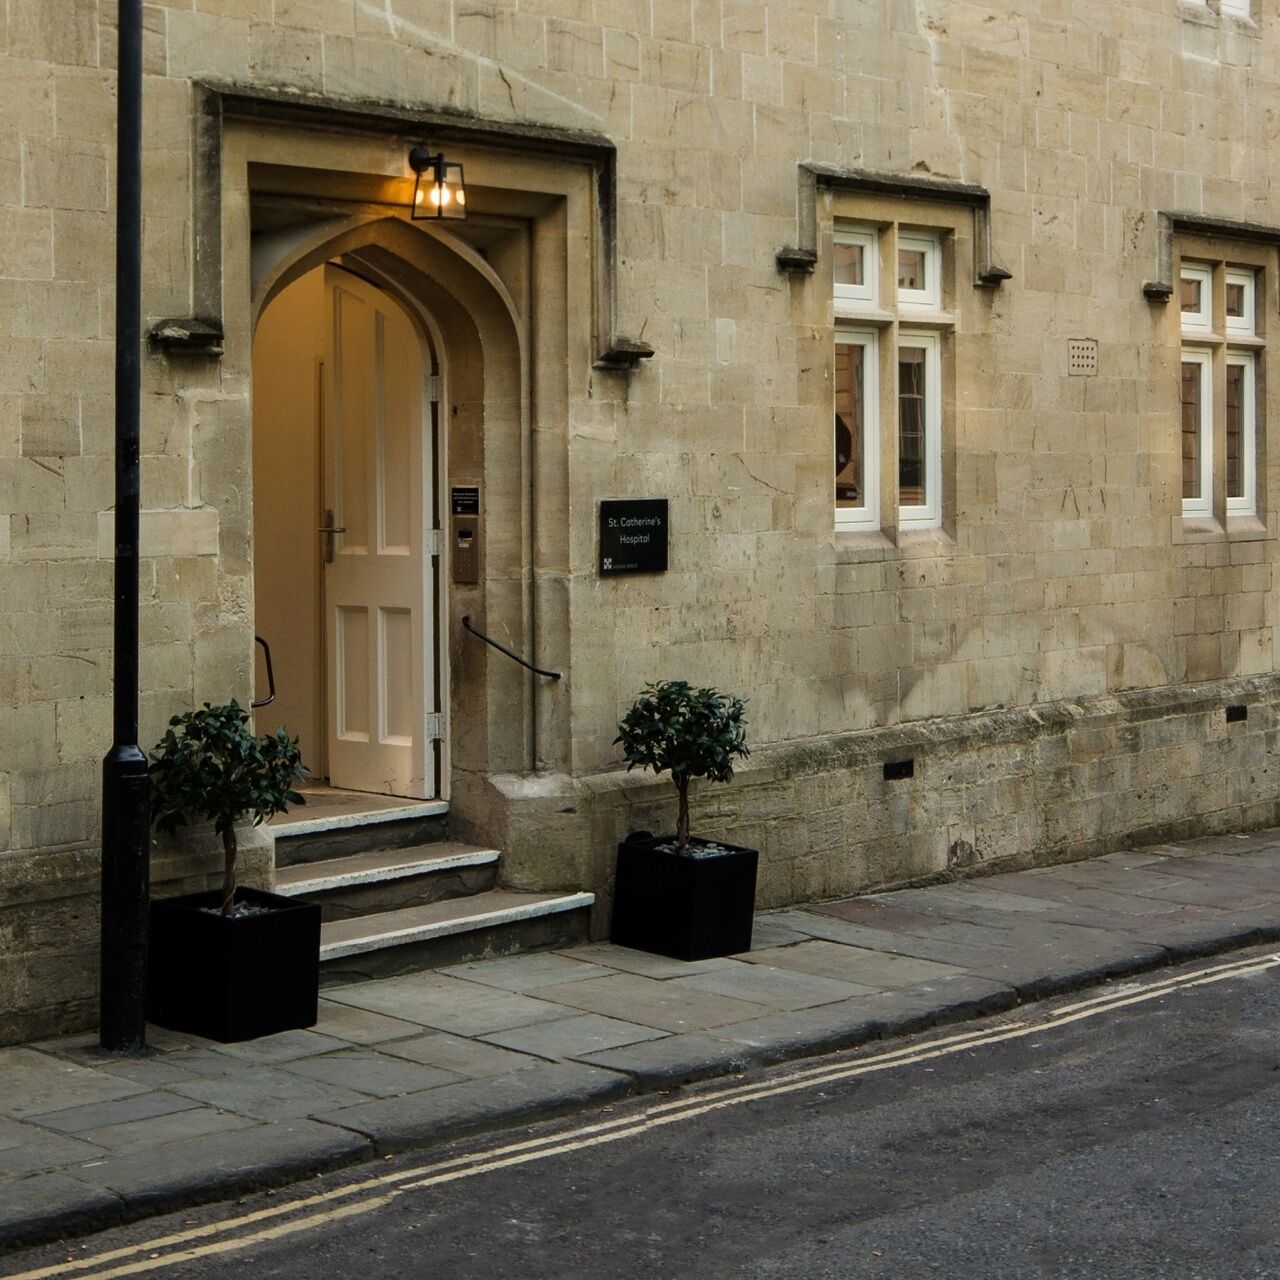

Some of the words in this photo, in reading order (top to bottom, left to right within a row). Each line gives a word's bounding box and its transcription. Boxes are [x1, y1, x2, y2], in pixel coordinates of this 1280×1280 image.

[608, 518, 619, 528] St.
[620, 516, 661, 528] Catherine's
[620, 534, 650, 545] Hospital
